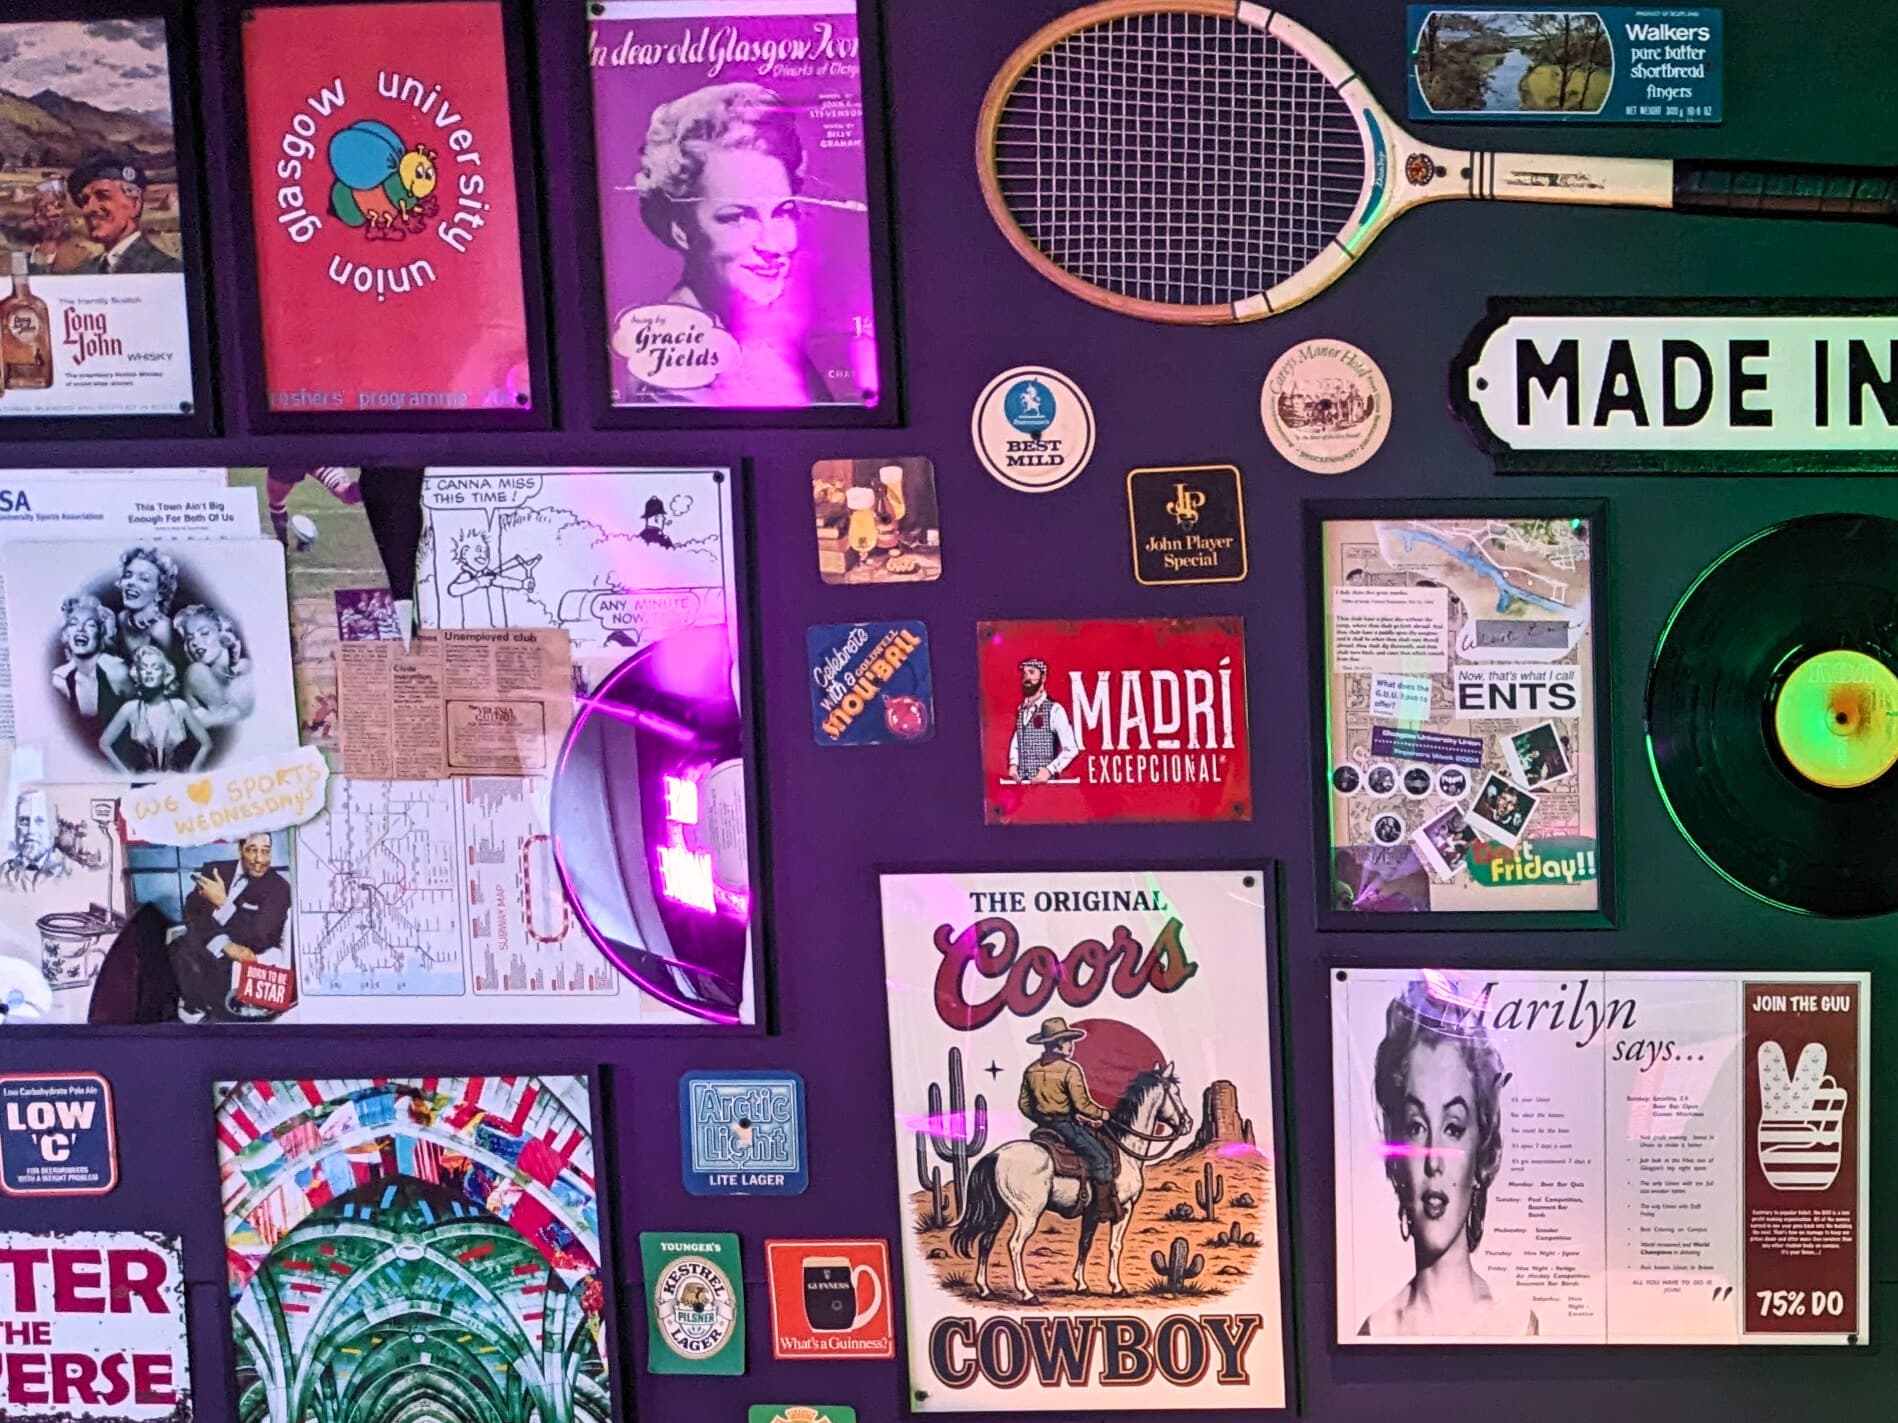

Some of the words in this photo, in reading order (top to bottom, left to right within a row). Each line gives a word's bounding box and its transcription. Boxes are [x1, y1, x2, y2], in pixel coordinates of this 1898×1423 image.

[1625, 24, 1711, 42] Walkers
[1630, 46, 1661, 62] pure
[1664, 45, 1706, 61] butter
[1629, 62, 1705, 79] shortbread
[1646, 82, 1693, 101] fingers
[276, 78, 347, 245] glasgow
[376, 69, 493, 253] university
[327, 254, 437, 302] union
[63, 307, 108, 345] Long
[635, 324, 704, 347] Gracie
[72, 332, 123, 365] John
[127, 352, 173, 363] WHISKY
[648, 347, 719, 377] Fields
[1516, 339, 1773, 428] MADE
[1006, 439, 1062, 452] BEST
[1006, 454, 1065, 467] MILD
[128, 514, 160, 527] Enough
[163, 514, 178, 524] For
[180, 514, 203, 524] Both
[206, 513, 217, 523] Of
[220, 513, 235, 524] Us
[135, 502, 155, 512] This
[157, 502, 183, 512] Town
[185, 502, 208, 512] Ain't
[211, 502, 225, 515] Big
[1145, 536, 1183, 553] John
[1185, 534, 1234, 553] Player
[1163, 551, 1219, 569] Special
[813, 628, 869, 688] Celebrate
[1067, 657, 1237, 753] MADRÍ
[1459, 682, 1577, 711] ENTS
[1087, 754, 1222, 784] EXCEPCIONAL
[1490, 851, 1596, 884] Friday!!
[970, 892, 1027, 914] THE
[1033, 889, 1169, 914] ORIGINAL
[933, 915, 1200, 1033] Coors
[1752, 996, 1786, 1012] JOIN
[1789, 995, 1817, 1012] THE
[1821, 995, 1850, 1012] GUU
[1612, 1034, 1706, 1075] says...
[5, 1101, 96, 1131] LOW
[709, 1173, 738, 1188] LITE
[741, 1172, 785, 1188] LAGER
[662, 1262, 726, 1300] KESTREL
[1757, 1290, 1806, 1317] 75%
[1811, 1290, 1844, 1316] DO
[670, 1327, 722, 1355] LAGER
[929, 1313, 1263, 1389] COWBOY
